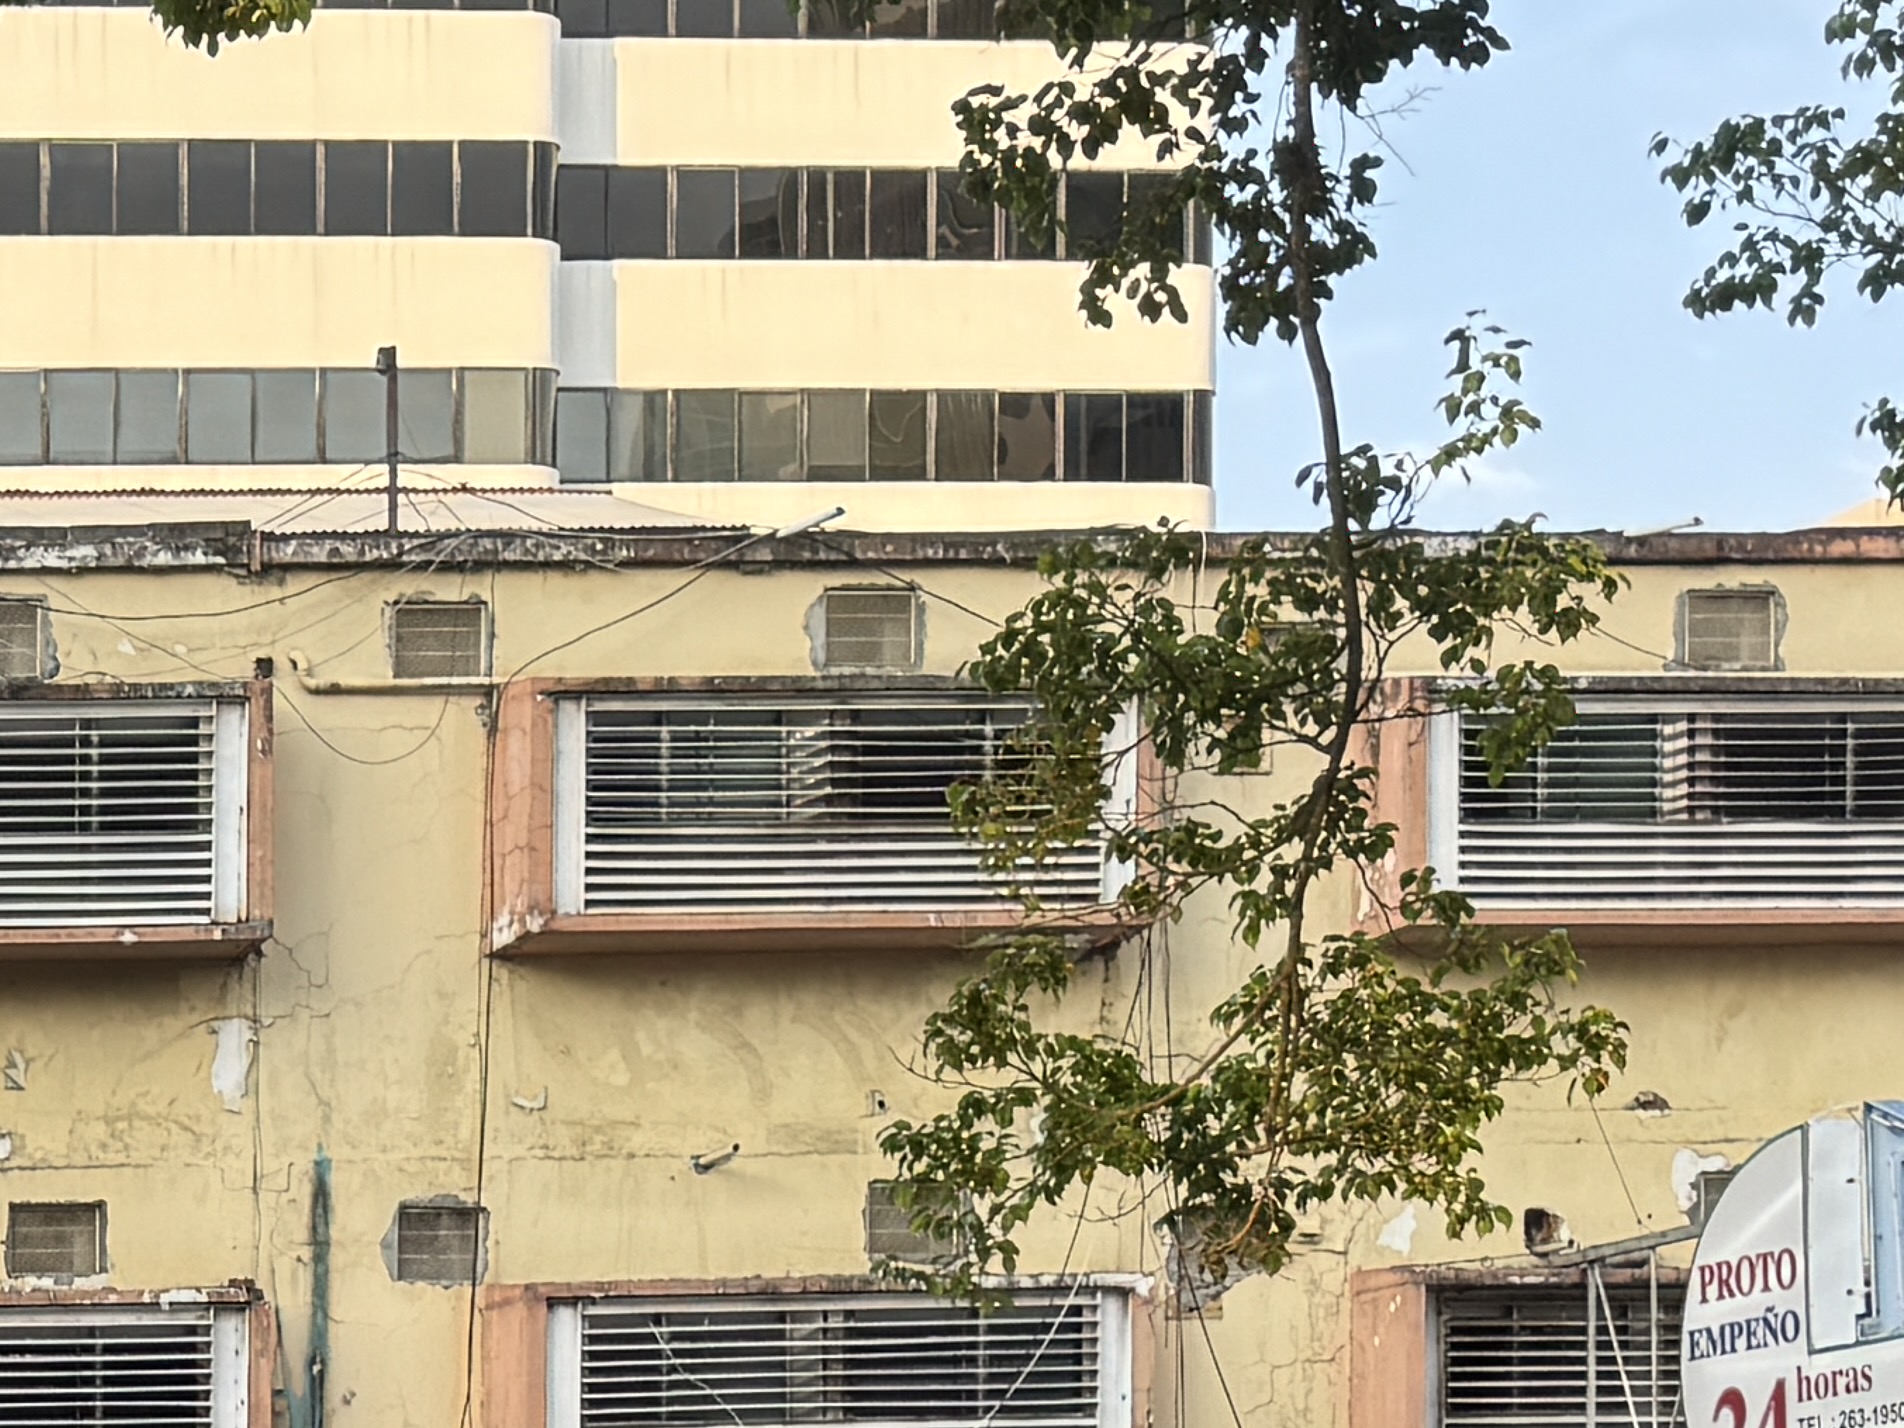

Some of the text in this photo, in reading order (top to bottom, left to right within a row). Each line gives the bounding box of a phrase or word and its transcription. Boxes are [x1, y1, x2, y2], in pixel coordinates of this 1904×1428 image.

[1698, 1248, 1797, 1304] PROTO
[1688, 1305, 1800, 1361] EMPEÑO
[1796, 1364, 1873, 1403] horas
